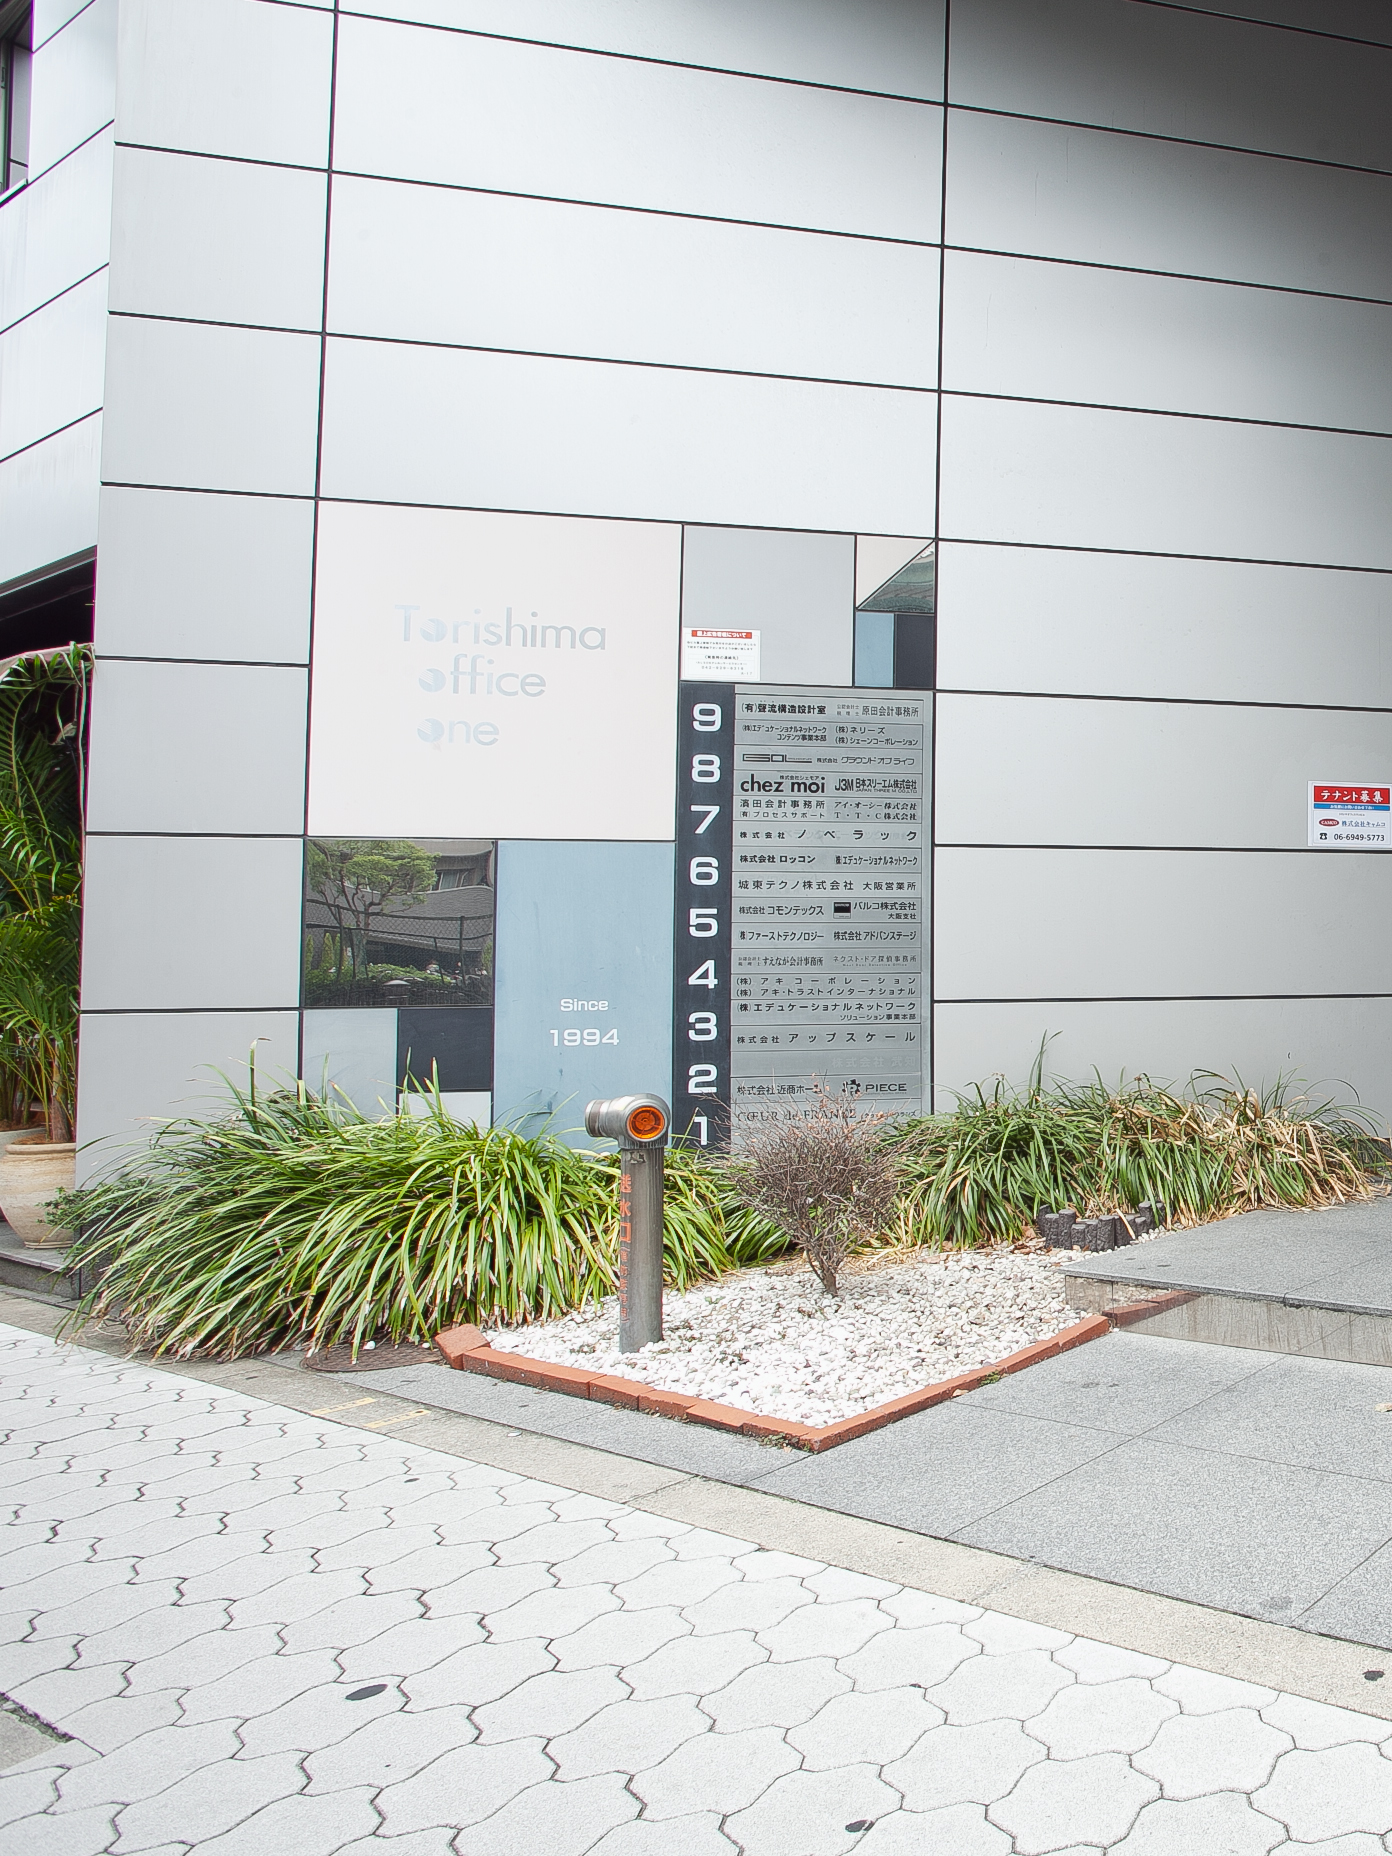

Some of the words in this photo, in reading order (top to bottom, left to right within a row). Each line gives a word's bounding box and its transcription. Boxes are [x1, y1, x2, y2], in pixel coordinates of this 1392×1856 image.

[394, 604, 606, 650] Torishima
[418, 654, 546, 698] office
[692, 703, 722, 731] 9
[862, 706, 919, 717] 原田会計事務所
[417, 718, 500, 746] one
[849, 737, 918, 746] シェーンコーポレーション
[691, 754, 721, 783] 8
[741, 774, 784, 792] chez
[791, 777, 825, 793] moi
[856, 779, 917, 789] 日本スリーエム株式会社
[1321, 790, 1383, 803] テナント募集
[690, 805, 720, 834] 7
[740, 855, 776, 863] 株式会社
[780, 855, 816, 863] ロッコン
[689, 856, 719, 885] 6
[738, 880, 854, 891] 城東テクノ株式会社
[862, 882, 917, 891] 大阪営業所
[767, 905, 824, 915] コモンテックス
[853, 902, 917, 910] バルコ株式会社
[689, 908, 719, 937] 5
[833, 931, 862, 940] 株式会社
[688, 959, 719, 989] 4
[560, 997, 609, 1011] Since
[688, 1012, 718, 1041] 3
[549, 1028, 620, 1046] 1994
[737, 1036, 780, 1044] 株式会社
[788, 1033, 916, 1043] アップスケール
[688, 1064, 718, 1093] 2
[865, 1083, 907, 1092] PIECE
[694, 1117, 708, 1146] 1
[620, 1174, 631, 1243] 送水口
